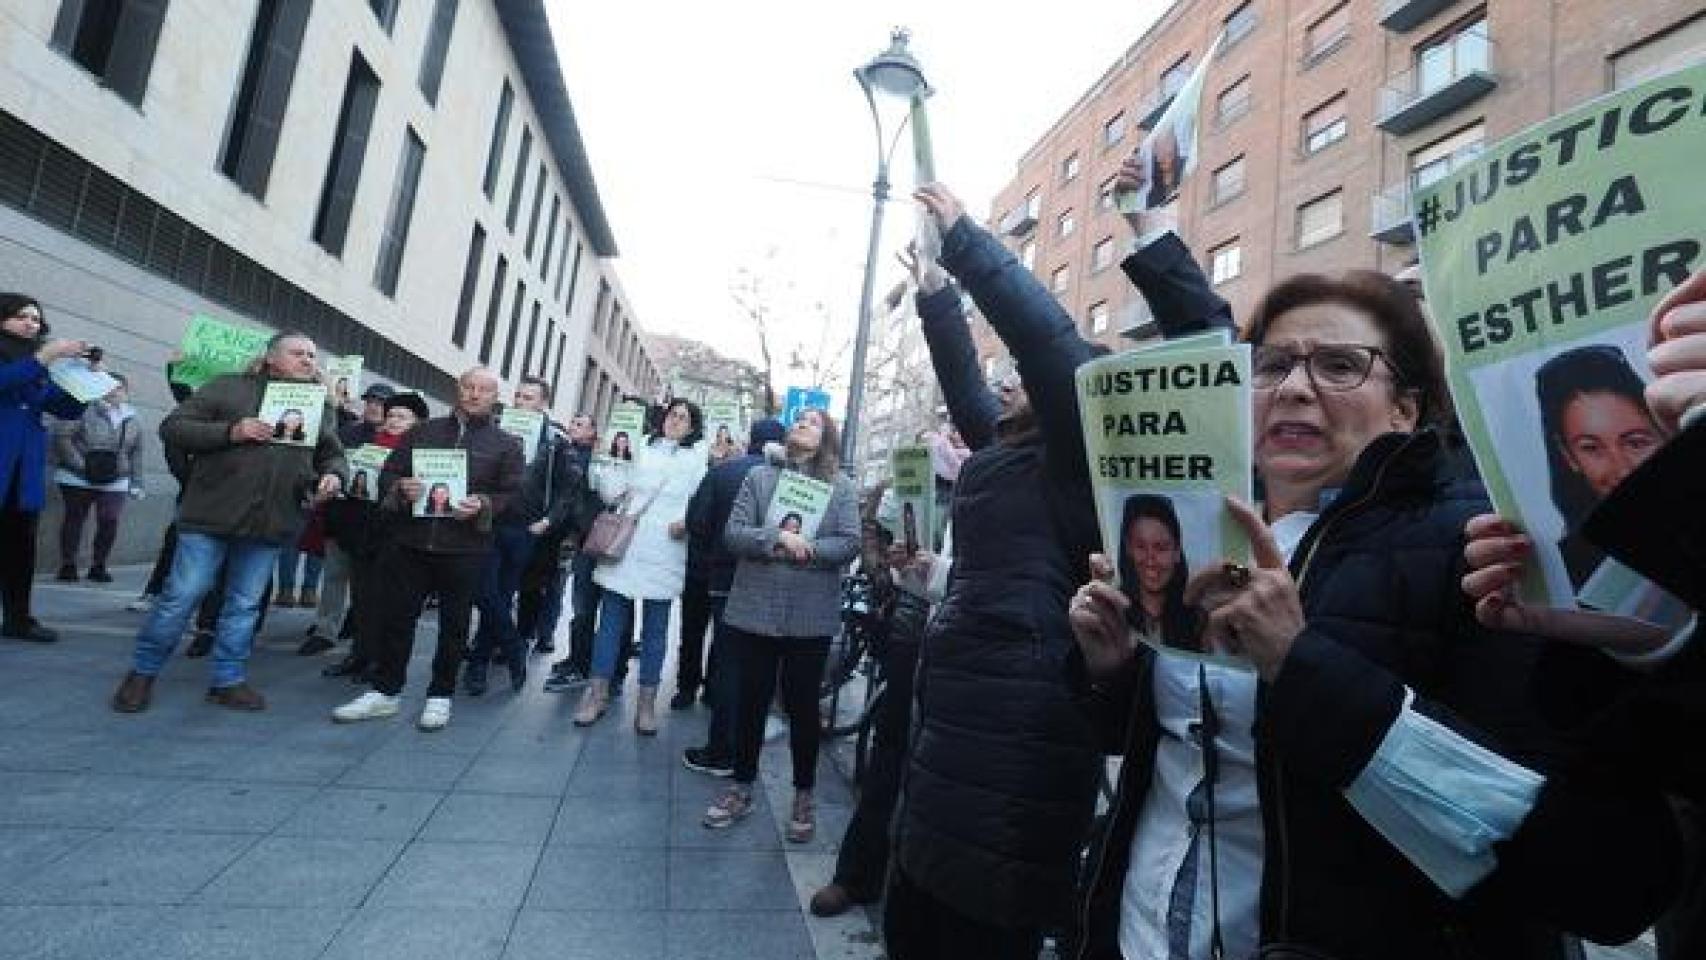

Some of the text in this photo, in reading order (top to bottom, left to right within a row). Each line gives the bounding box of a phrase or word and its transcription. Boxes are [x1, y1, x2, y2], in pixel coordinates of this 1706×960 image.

[1417, 87, 1706, 237] #JUSTIC
[1476, 174, 1646, 276] PARA
[1457, 239, 1701, 354] ESTHER
[1100, 454, 1215, 480] ESTHER
[1103, 411, 1187, 437] PARA
